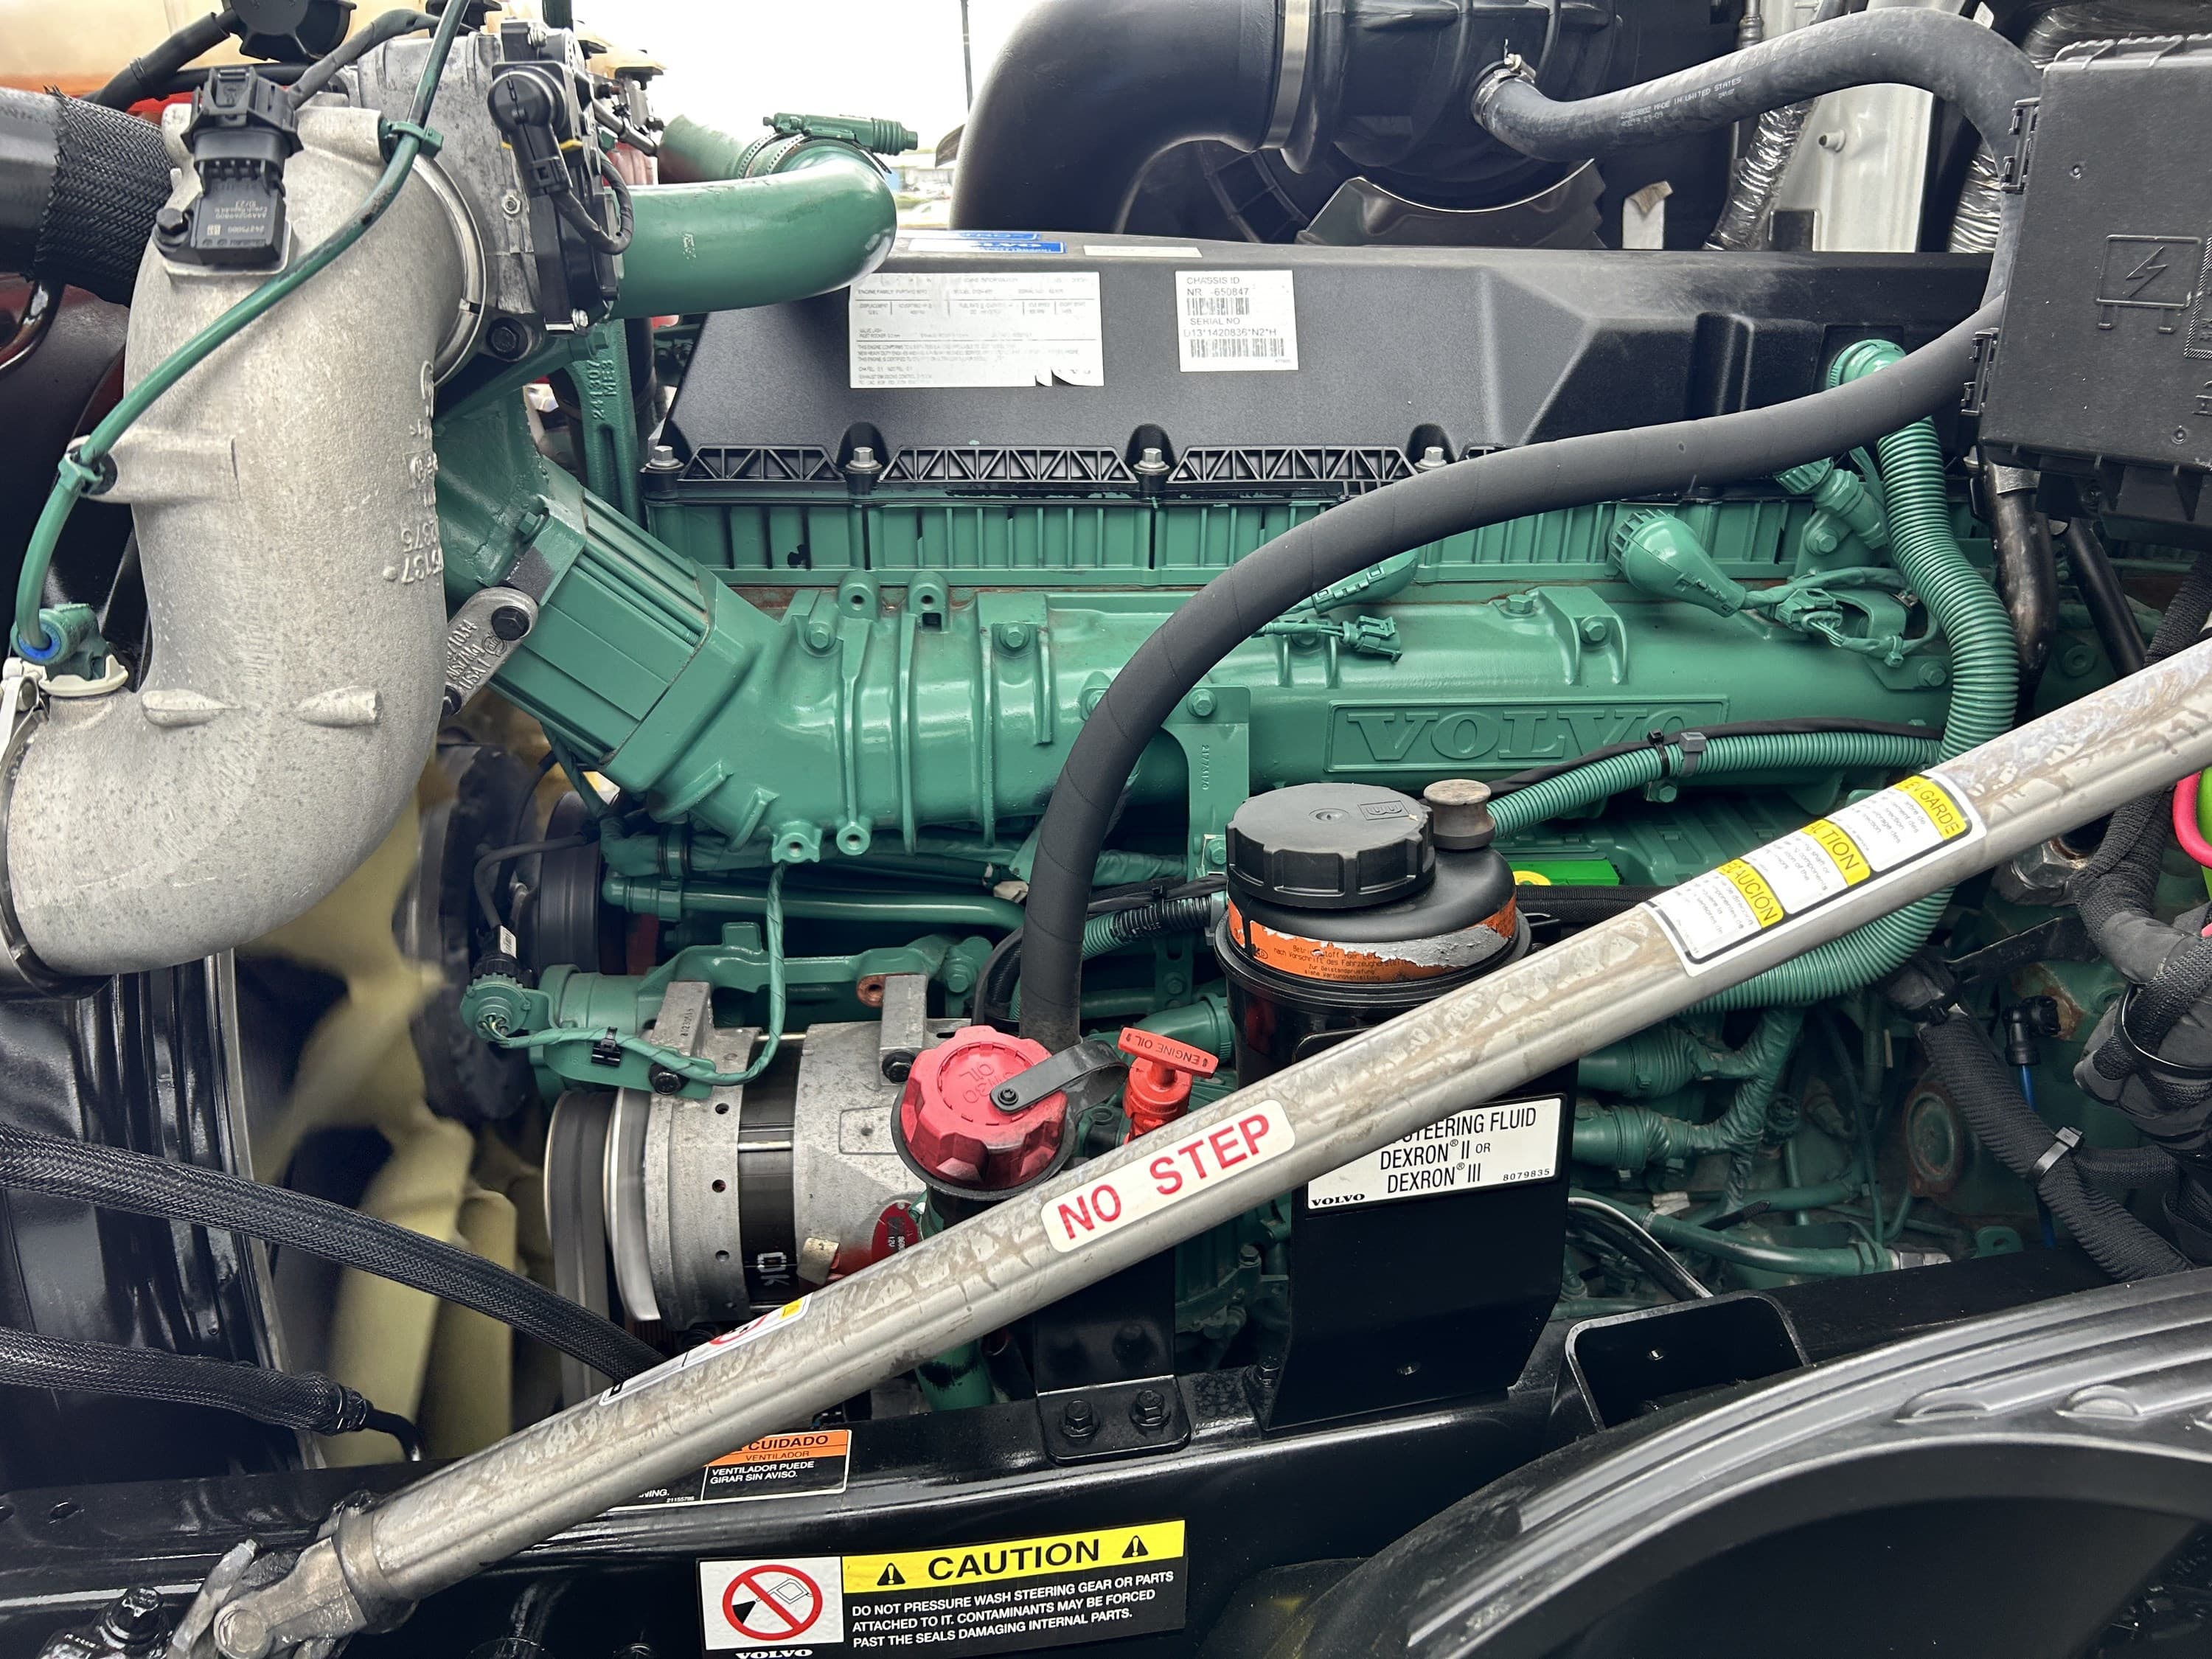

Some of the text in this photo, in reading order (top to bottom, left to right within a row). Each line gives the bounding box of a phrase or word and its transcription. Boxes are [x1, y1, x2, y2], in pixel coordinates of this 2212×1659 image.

[1685, 88, 1711, 101] UNITED
[1714, 77, 1742, 91] STATES
[1186, 276, 1228, 285] CHASSIS
[1187, 288, 1202, 296] NR
[1226, 317, 1240, 325] NO
[459, 666, 487, 689] USA
[1920, 790, 1960, 834] GARDE
[1809, 823, 1860, 870] ATION
[1722, 861, 1778, 921] ECAUCIÓN
[1273, 947, 1287, 956] nach
[1135, 1035, 1201, 1066] ENGINE OIL
[959, 1064, 995, 1082] OIL
[1490, 1107, 1537, 1131] FLUID
[1461, 1141, 1470, 1159] II
[1475, 1143, 1491, 1154] OR
[1057, 1114, 1270, 1239] NO STEP
[1467, 1163, 1481, 1183] III
[1311, 1168, 1550, 1206] VOLVO 8079835
[748, 1435, 829, 1451] CUIDADO
[745, 1450, 810, 1461] VENTILADOR
[710, 1470, 798, 1484] GIRAR SIN AVISO.
[712, 1461, 814, 1476] VENTILADOR PUEDE
[928, 1539, 1099, 1580] CAUTION
[852, 1571, 1174, 1616] DO NOT PRESSURE WASH STEERING GEAR OR PARTS
[852, 1589, 1155, 1632] ATTACHED TO IT. CONTAMINANTS MAY BE FORCED
[853, 1608, 1133, 1648] PAST THE SEALS DAMAGING INTERNAL PARTS.
[736, 1649, 813, 1659] VOLVO
